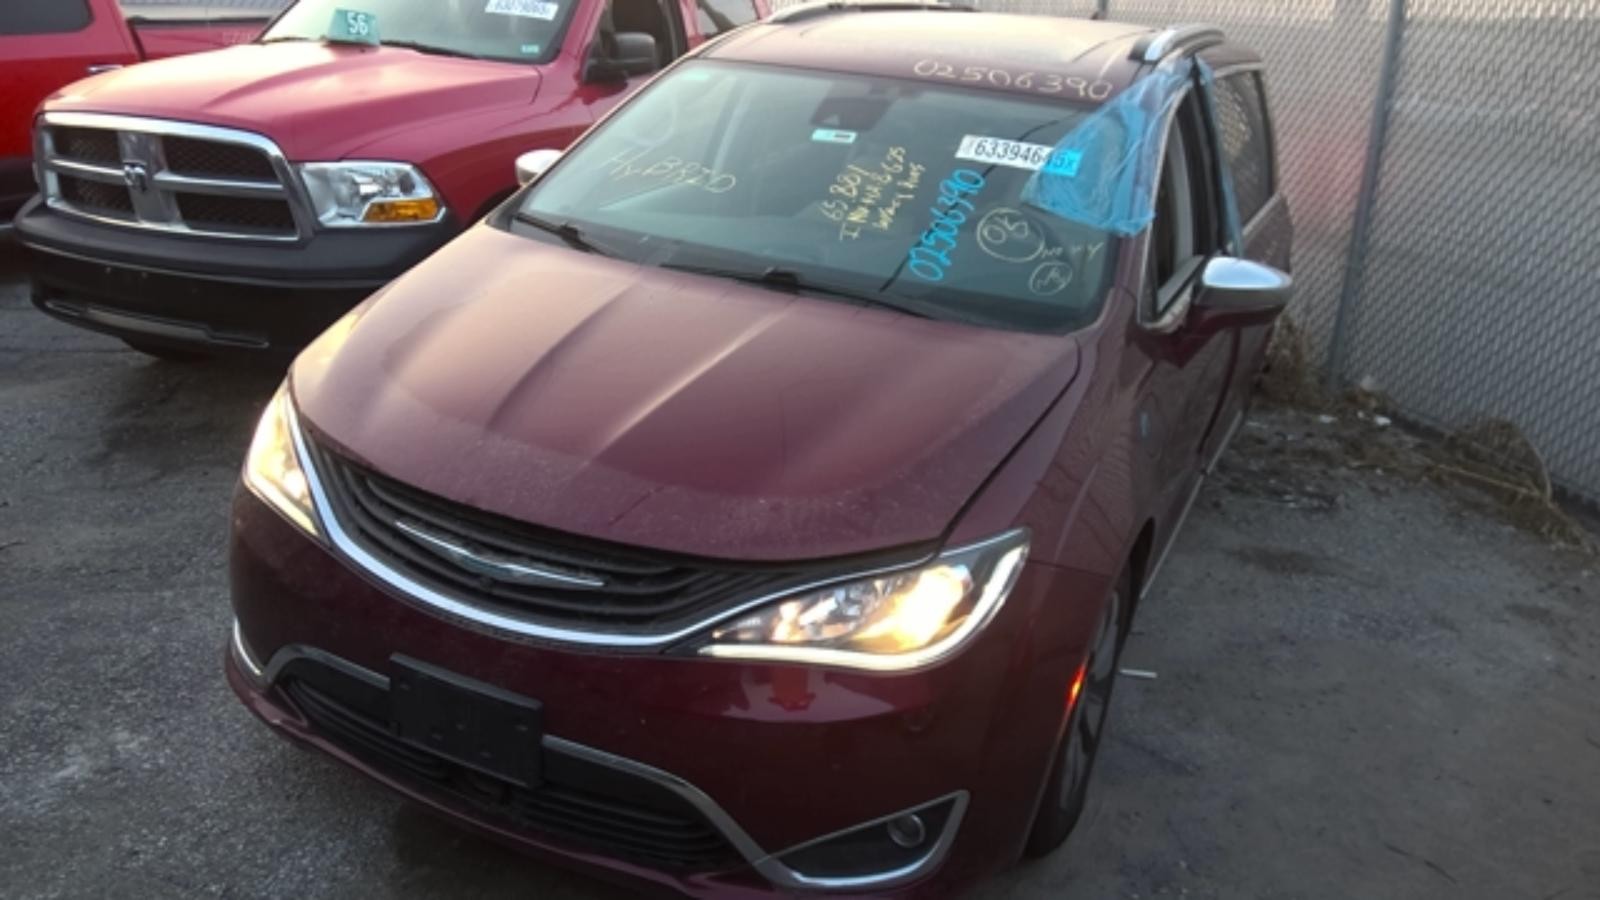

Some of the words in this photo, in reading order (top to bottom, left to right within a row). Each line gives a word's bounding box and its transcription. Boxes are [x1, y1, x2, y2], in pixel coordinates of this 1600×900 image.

[347, 11, 369, 36] 56
[912, 58, 1113, 100] 02506390
[908, 168, 986, 282] 02506390
